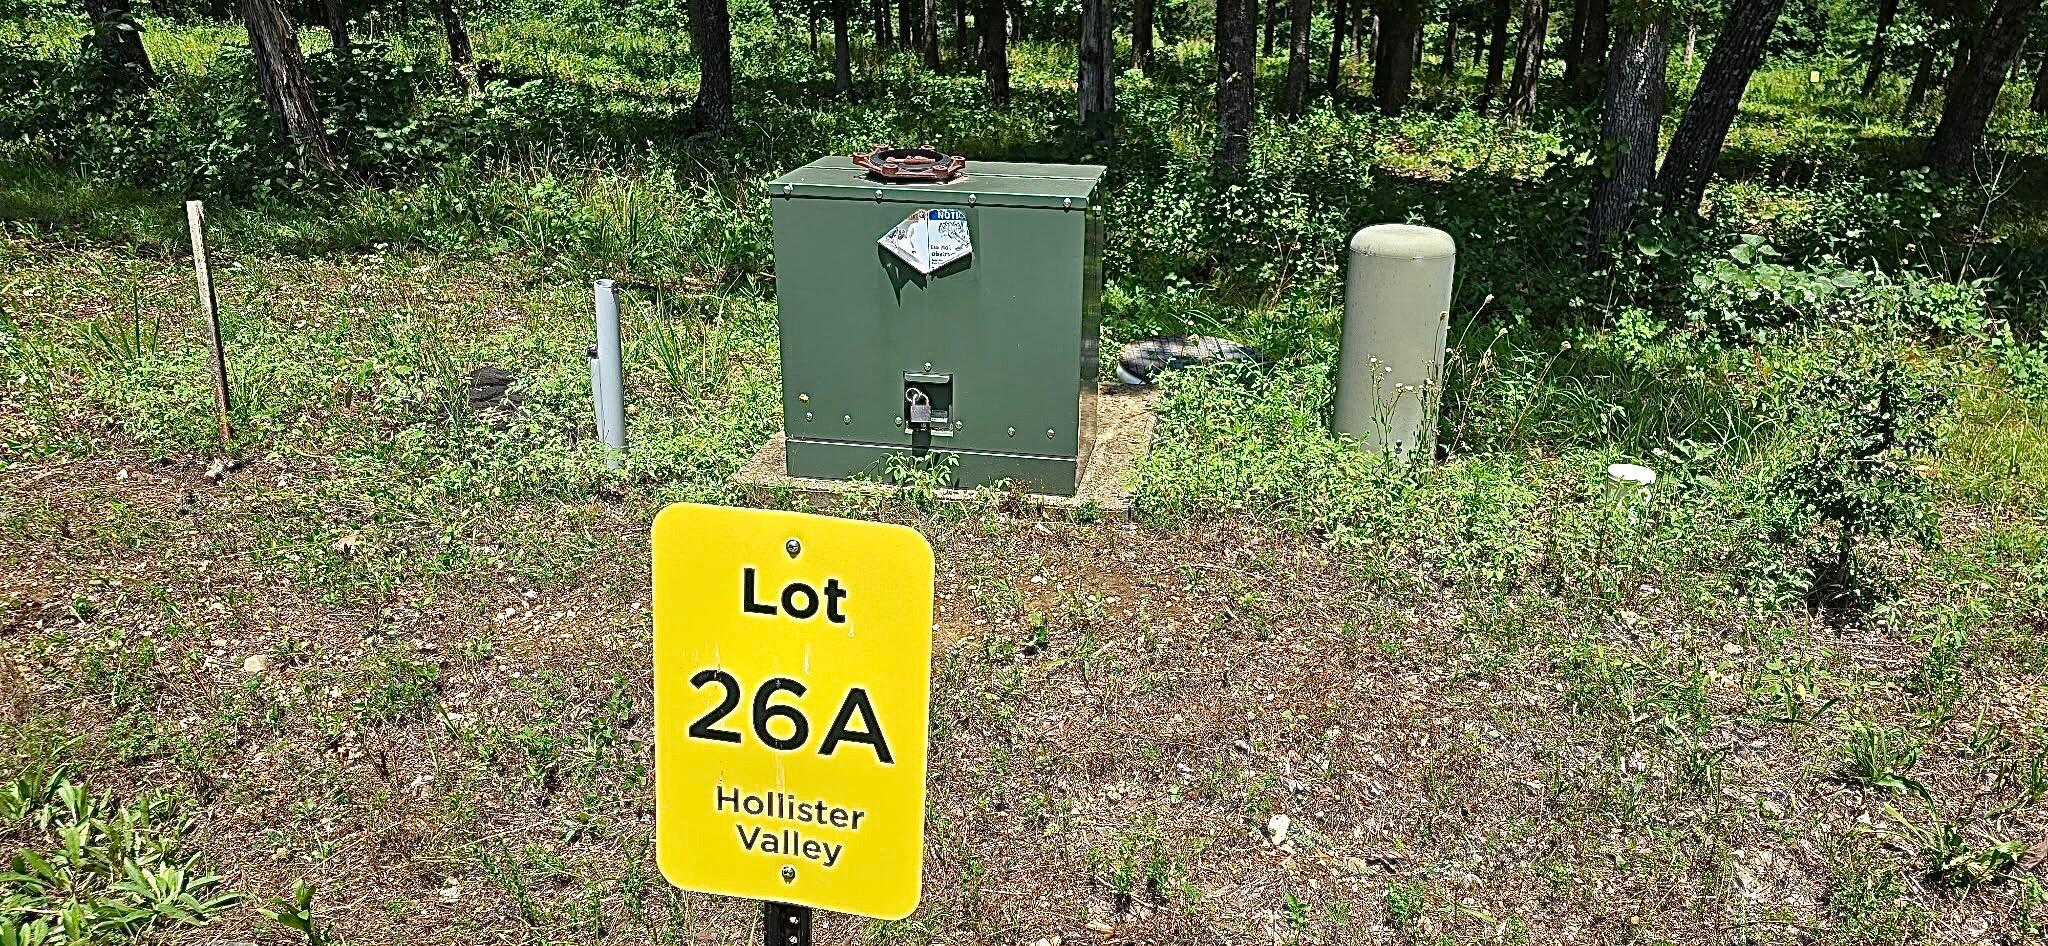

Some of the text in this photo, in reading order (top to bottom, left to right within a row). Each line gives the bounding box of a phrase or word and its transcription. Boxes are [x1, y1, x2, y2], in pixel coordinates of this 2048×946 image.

[742, 566, 848, 624] Lot
[688, 669, 895, 765] 26A
[716, 785, 866, 830] Hollister
[736, 824, 843, 867] Valley
